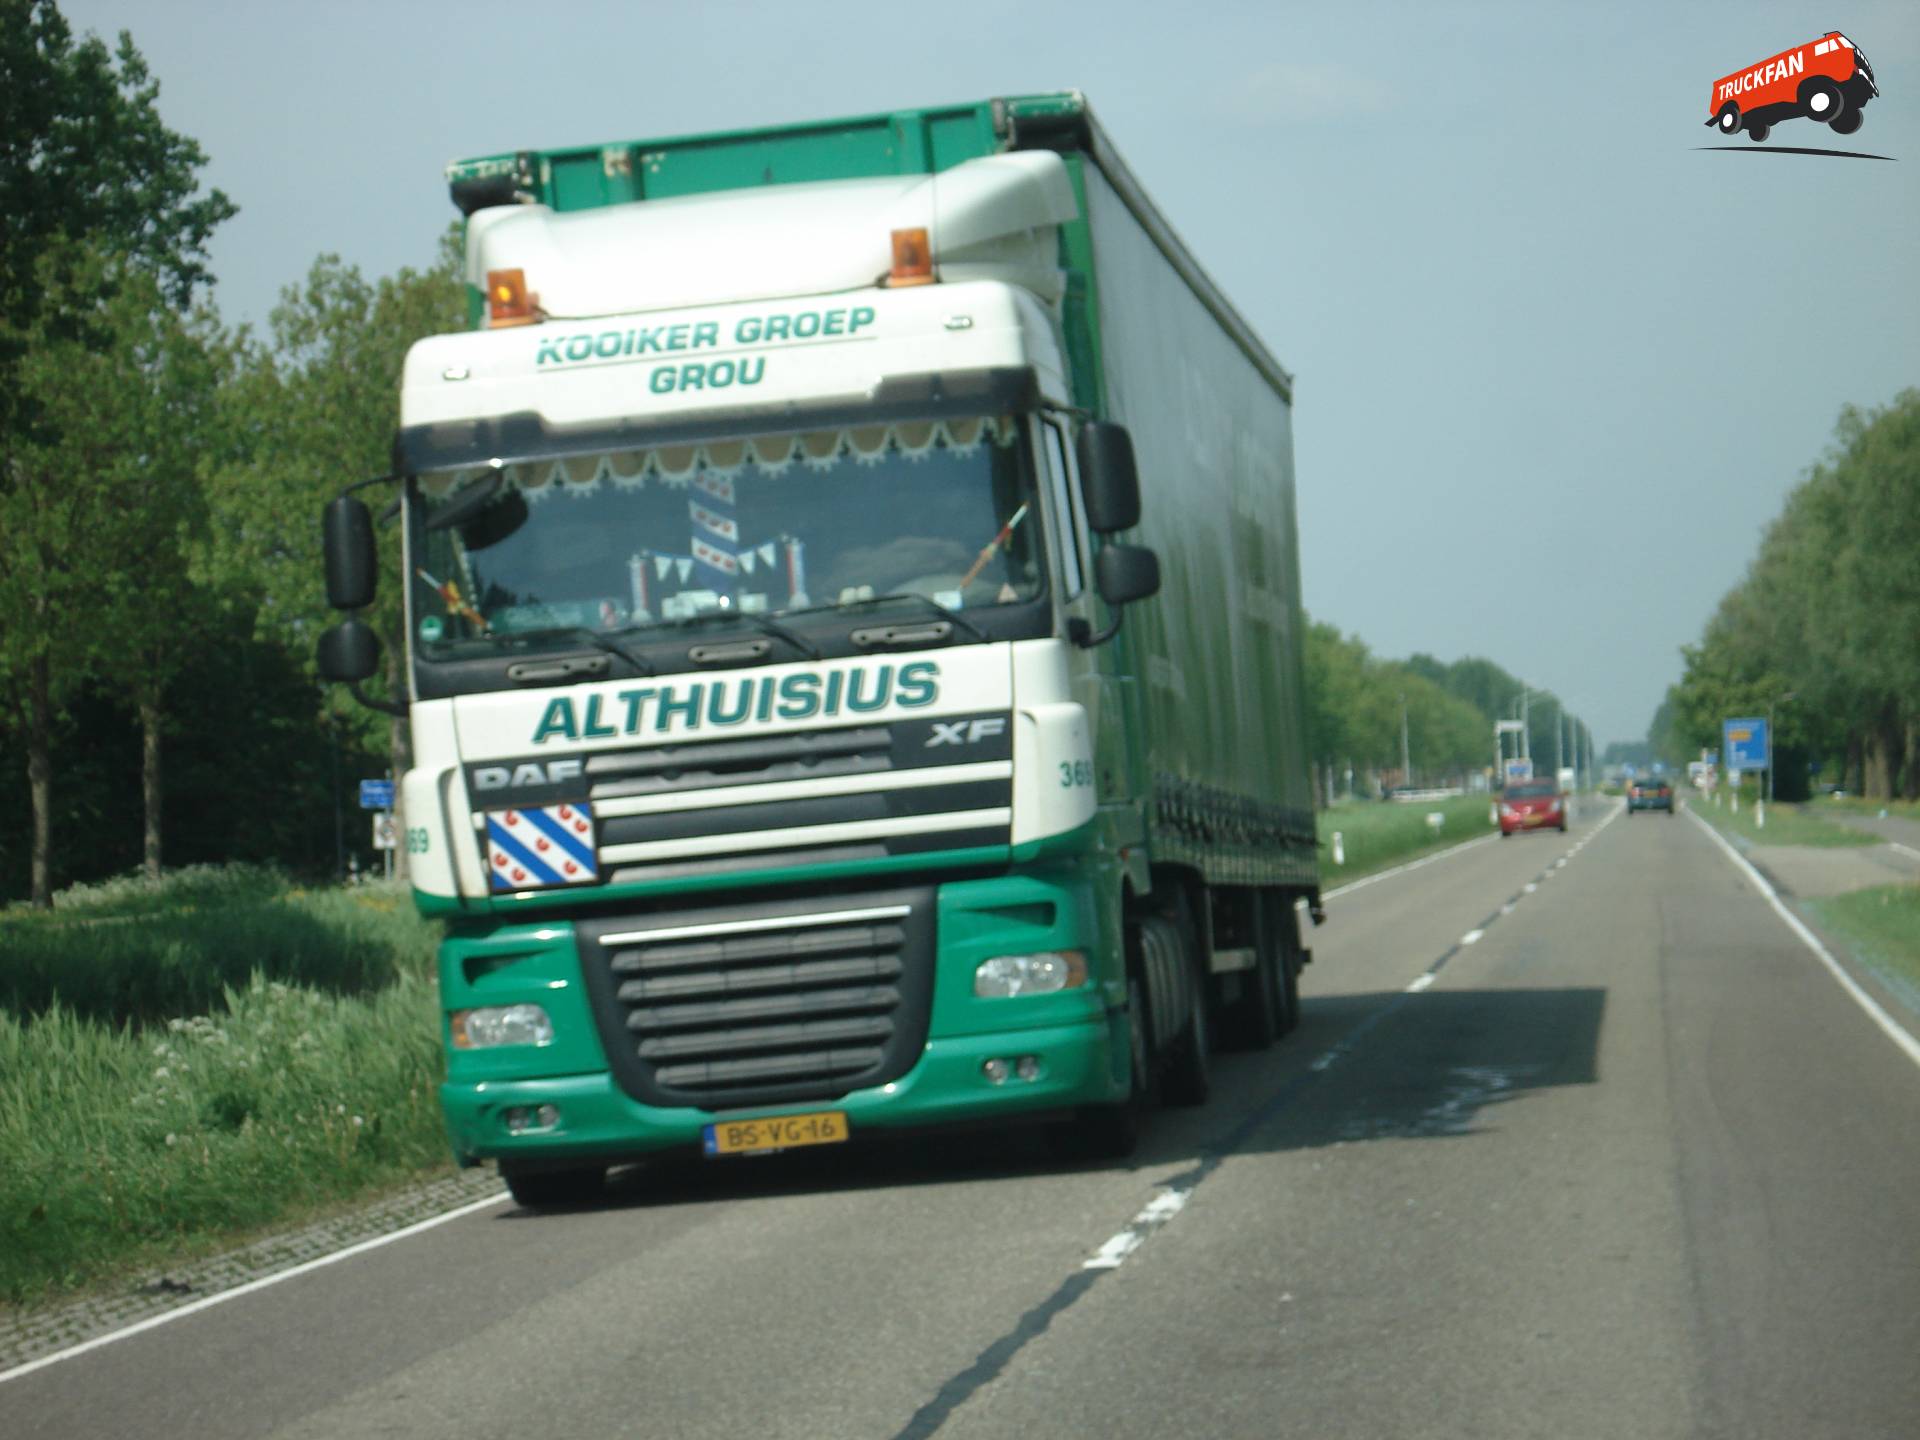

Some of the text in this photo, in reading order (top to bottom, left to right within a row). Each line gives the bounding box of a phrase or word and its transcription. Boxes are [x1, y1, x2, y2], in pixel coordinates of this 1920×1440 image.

[536, 306, 876, 365] KOOIKER GROEP
[648, 356, 766, 395] GROU
[530, 661, 942, 744] ALTHUISIUS
[925, 717, 1007, 749] XF
[474, 758, 583, 792] DAF
